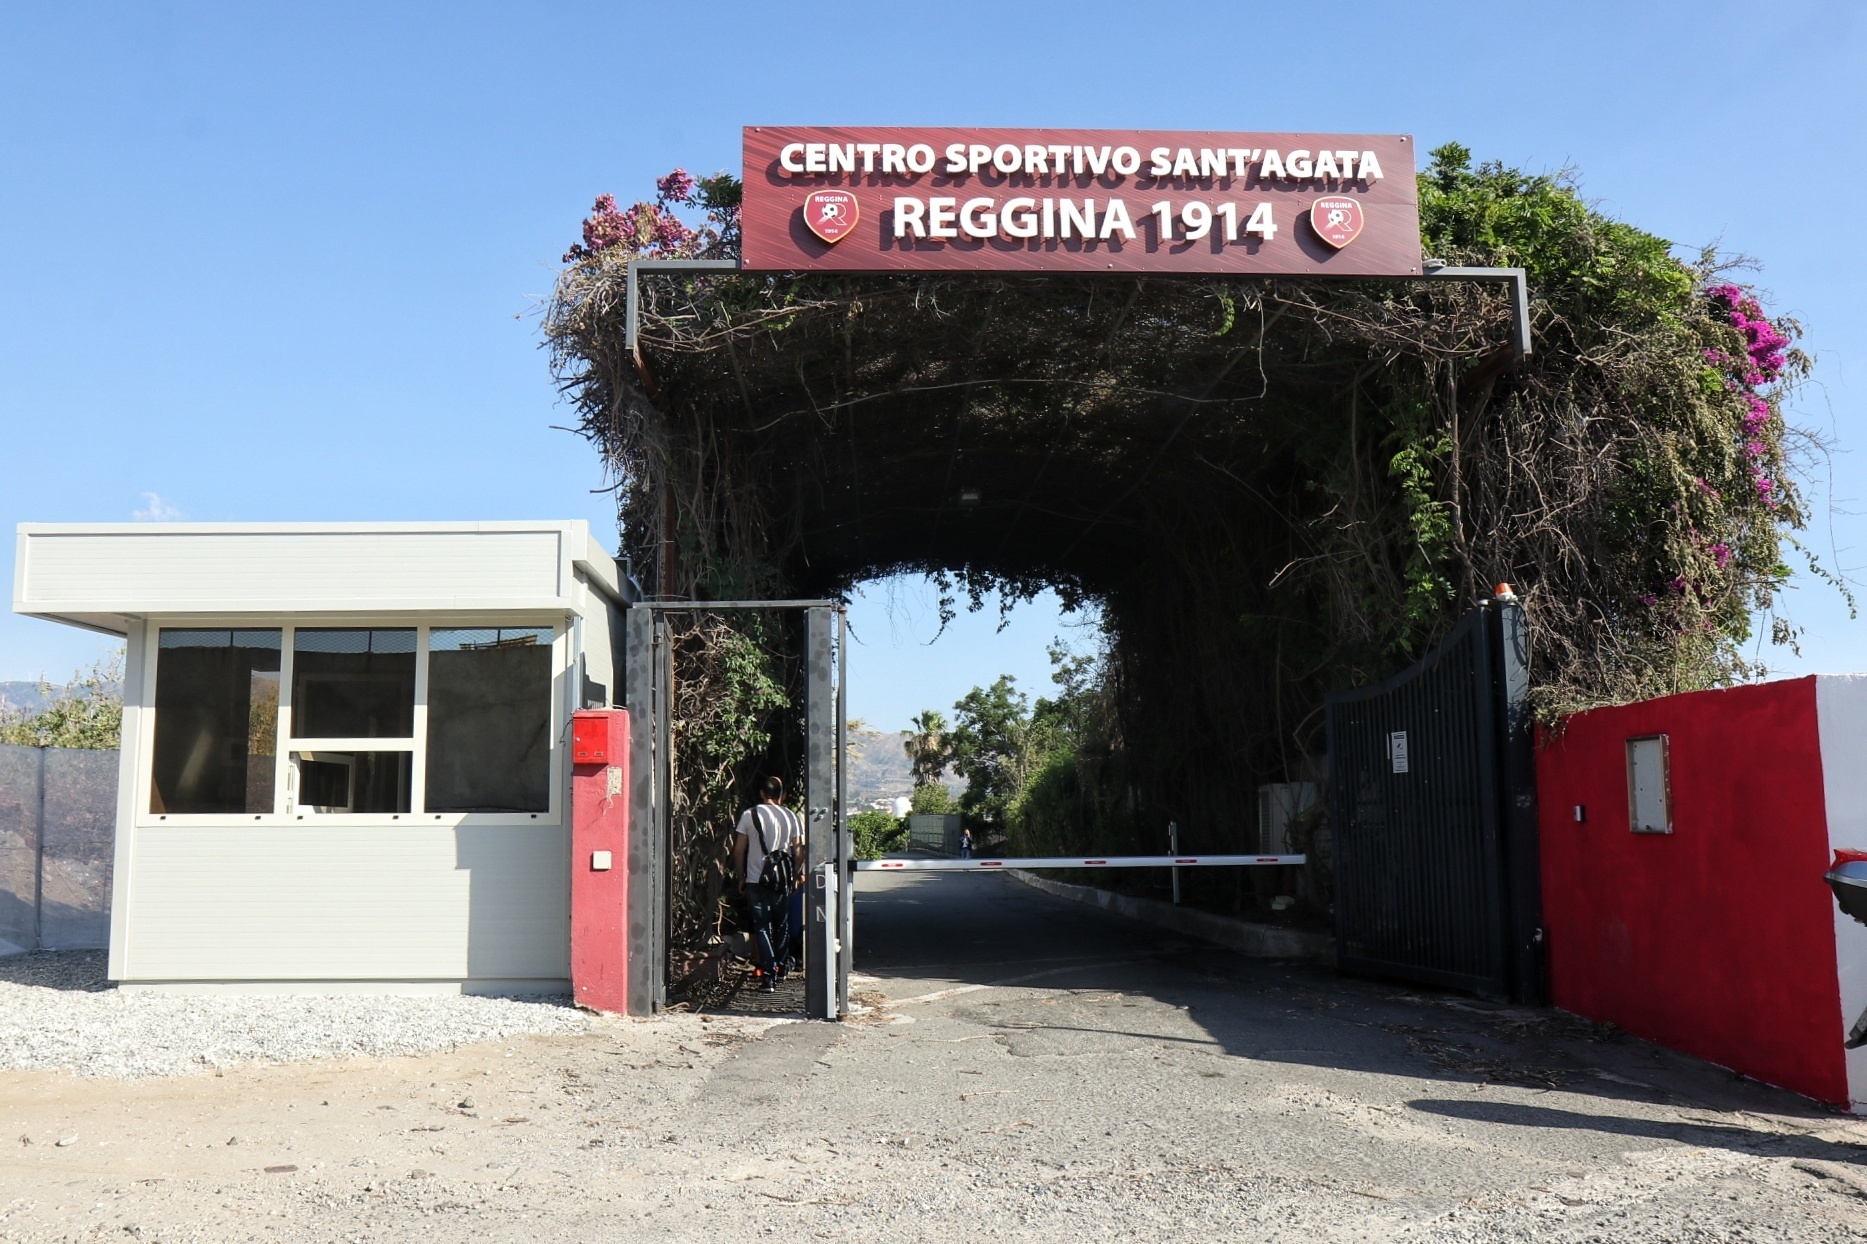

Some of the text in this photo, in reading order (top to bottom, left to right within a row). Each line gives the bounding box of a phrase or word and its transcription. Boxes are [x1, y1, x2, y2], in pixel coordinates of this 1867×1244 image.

[780, 143, 1384, 179] CENTRO SPORTIVO SANT'AGATA
[893, 197, 1278, 241] REGGINA 1914
